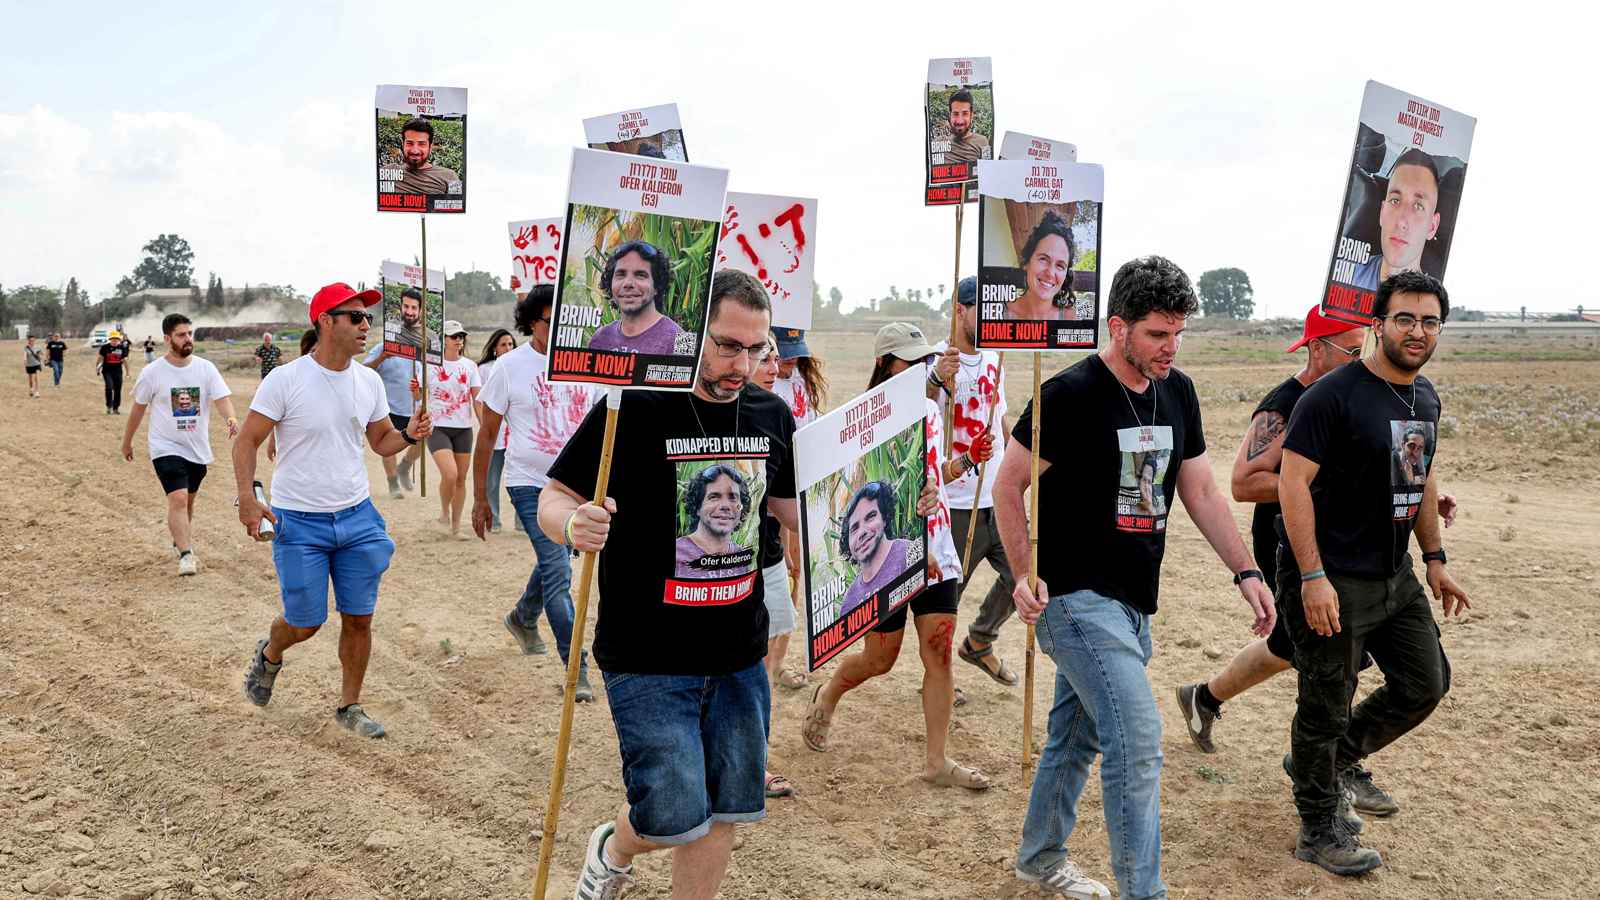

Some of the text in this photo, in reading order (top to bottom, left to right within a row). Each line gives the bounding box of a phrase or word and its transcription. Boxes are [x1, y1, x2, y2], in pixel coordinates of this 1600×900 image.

[618, 118, 649, 131] CARMEL GAT
[1397, 112, 1444, 138] MATAN ANGREST
[931, 140, 952, 153] BRING
[932, 153, 945, 165] HIM
[379, 168, 404, 181] BRING
[629, 162, 678, 181] עופר קלדרון
[932, 165, 951, 178] HOME
[379, 181, 395, 193] HIM
[619, 176, 683, 197] OFER KALDERON
[1024, 177, 1064, 189] CARMEL GAT
[379, 194, 403, 207] HOME
[403, 193, 427, 208] NOW!
[641, 193, 659, 208] (53)
[1337, 236, 1371, 265] BRING
[1332, 259, 1355, 285] HIM
[981, 284, 1016, 302] BRING
[1327, 284, 1376, 314] HOME NO
[558, 303, 603, 328] BRING
[981, 302, 1004, 320] HER
[555, 326, 584, 348] HIM
[981, 320, 1048, 340] HOME NOW!
[553, 350, 637, 378] HOME NOW!
[645, 369, 692, 384] FAMILIES FORUM
[871, 391, 886, 410] עופר
[839, 403, 892, 444] OFER KALDERON
[665, 436, 770, 455] KIDNAPPED BY HAMAS
[859, 428, 874, 449] (53)
[1117, 504, 1131, 515] HER
[1118, 515, 1135, 527] HOME
[700, 552, 751, 566] Ofer Kalderon
[674, 585, 708, 602] BRING
[710, 584, 736, 601] THEM
[811, 574, 847, 614] BRING
[812, 602, 835, 636] HIM
[813, 593, 879, 659] HOME NOW!
